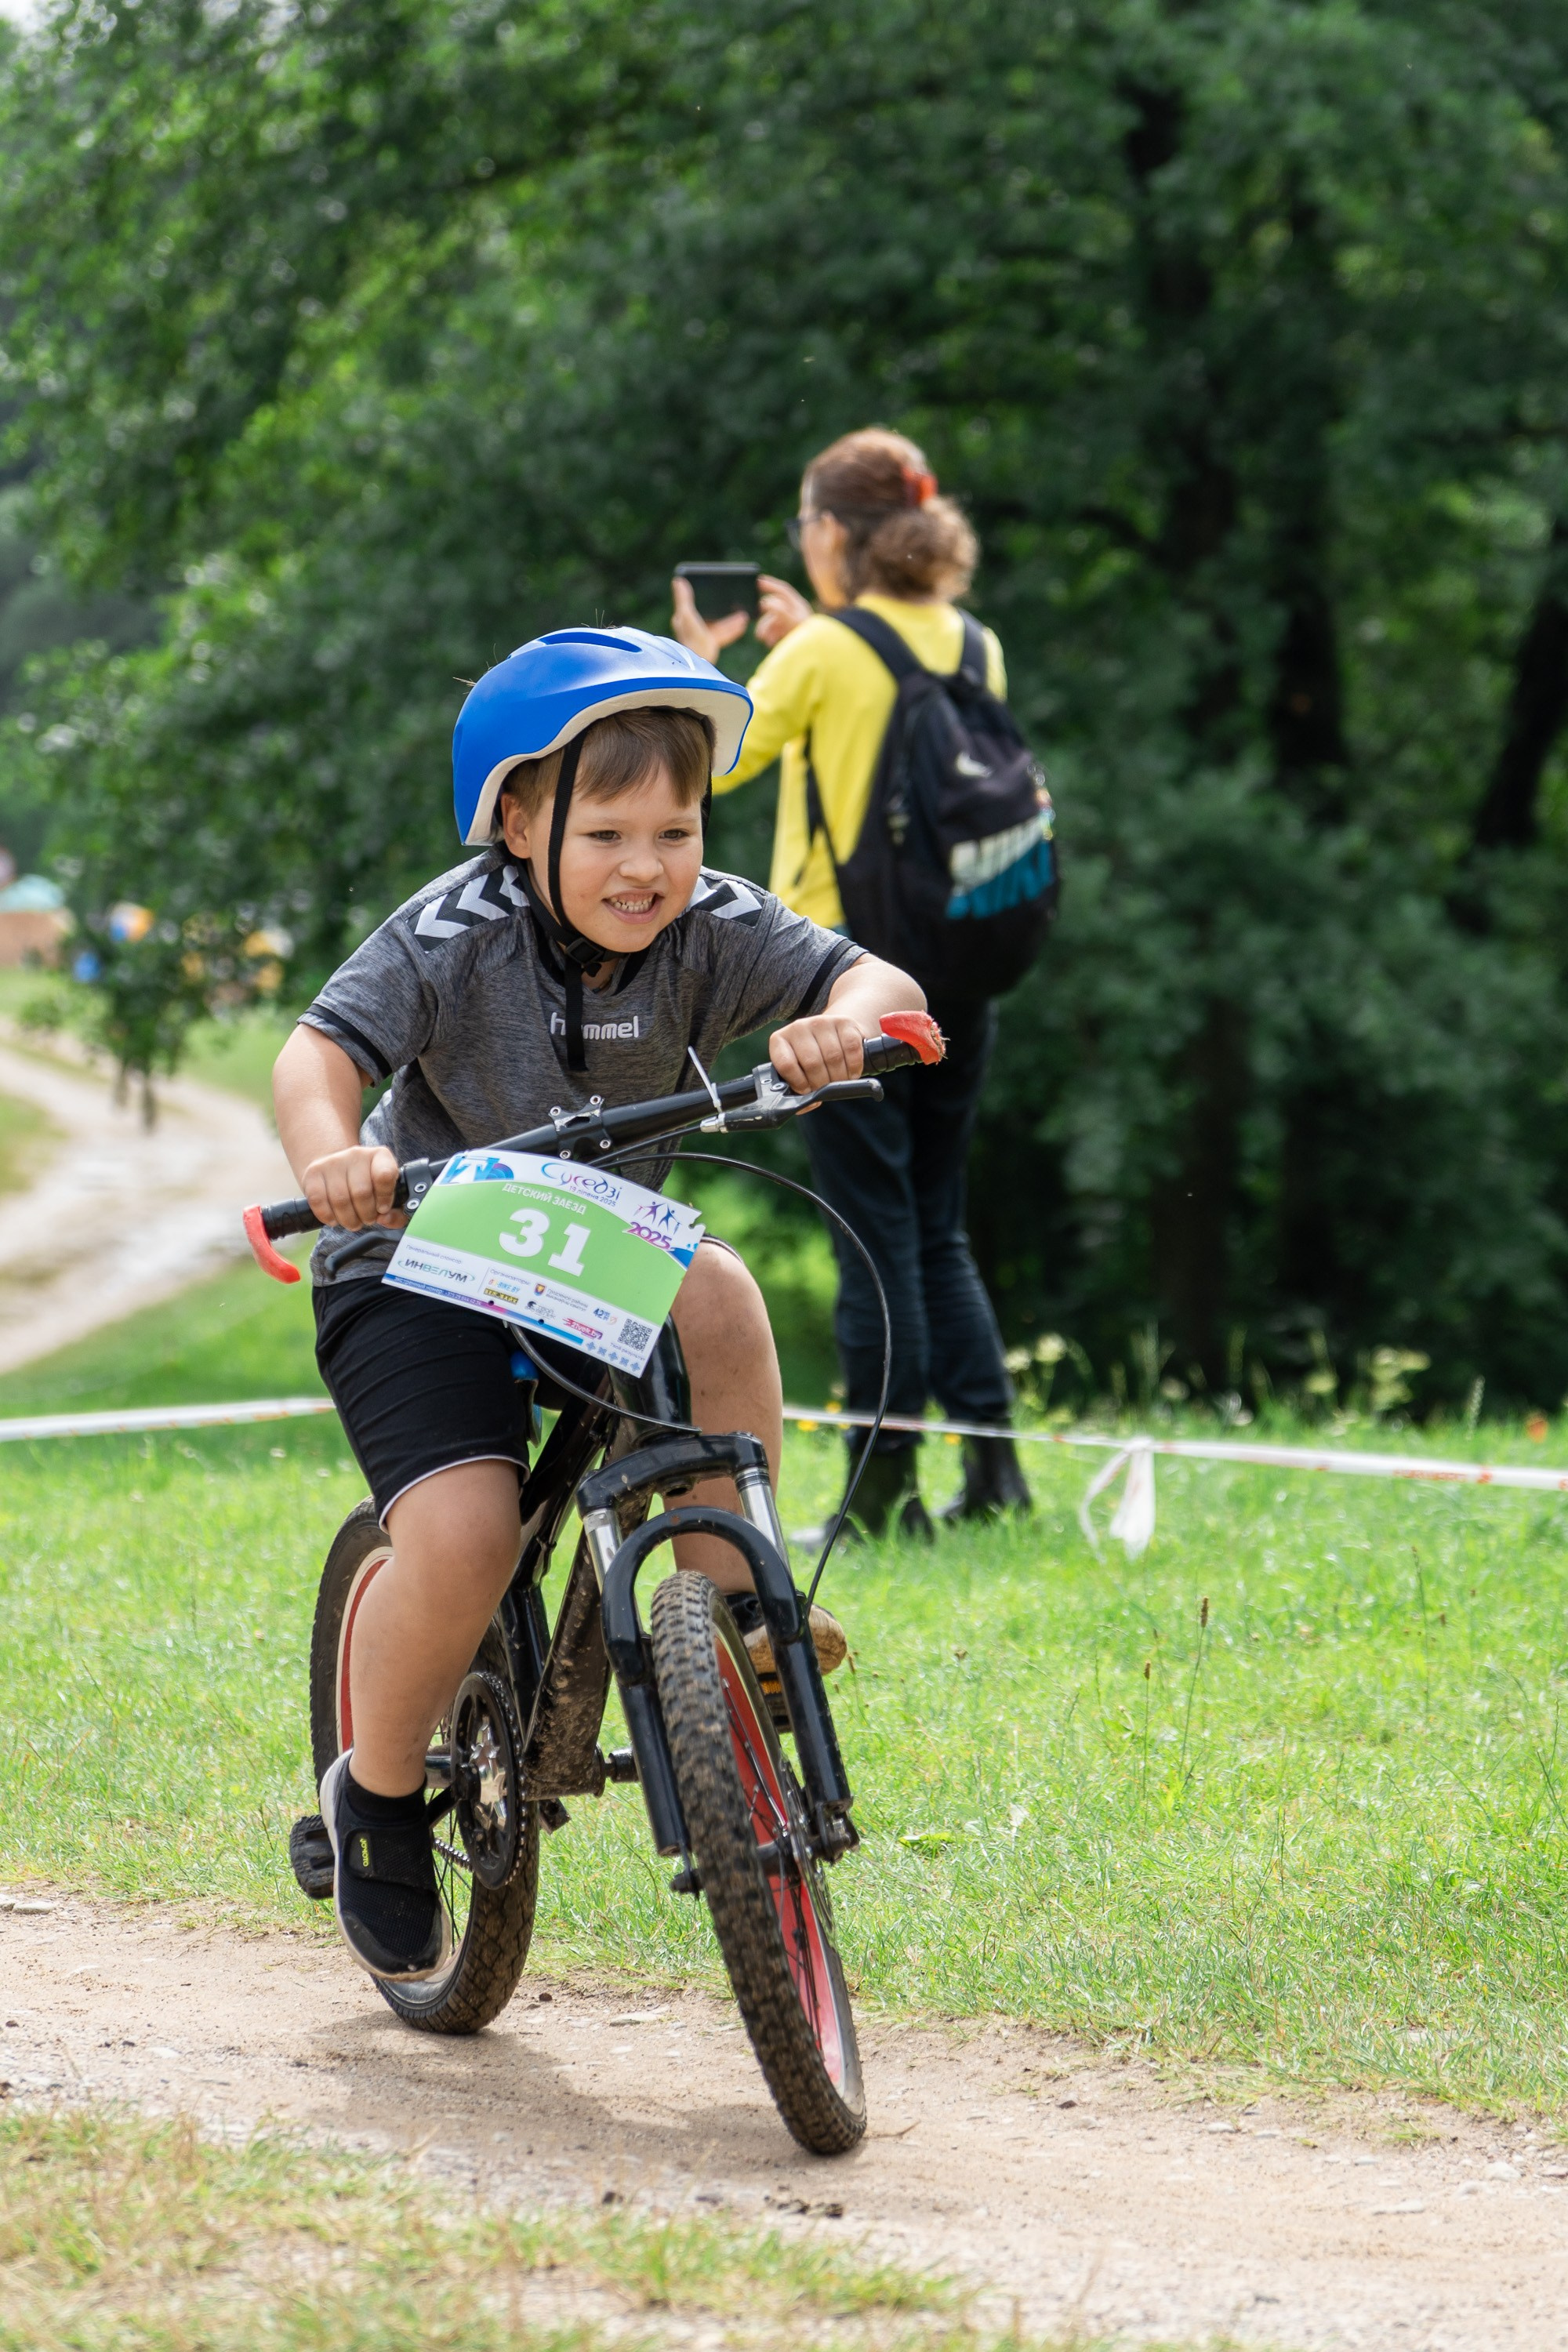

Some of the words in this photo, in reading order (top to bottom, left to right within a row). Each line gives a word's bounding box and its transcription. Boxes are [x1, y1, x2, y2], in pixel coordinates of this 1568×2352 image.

[550, 1012, 639, 1040] hmmel
[502, 1182, 552, 1203] ДЕТСКИЙ
[552, 1196, 587, 1215] ЗАЕЗД
[599, 1196, 616, 1207] 2025
[499, 1207, 591, 1277] 31
[627, 1221, 673, 1250] 2025
